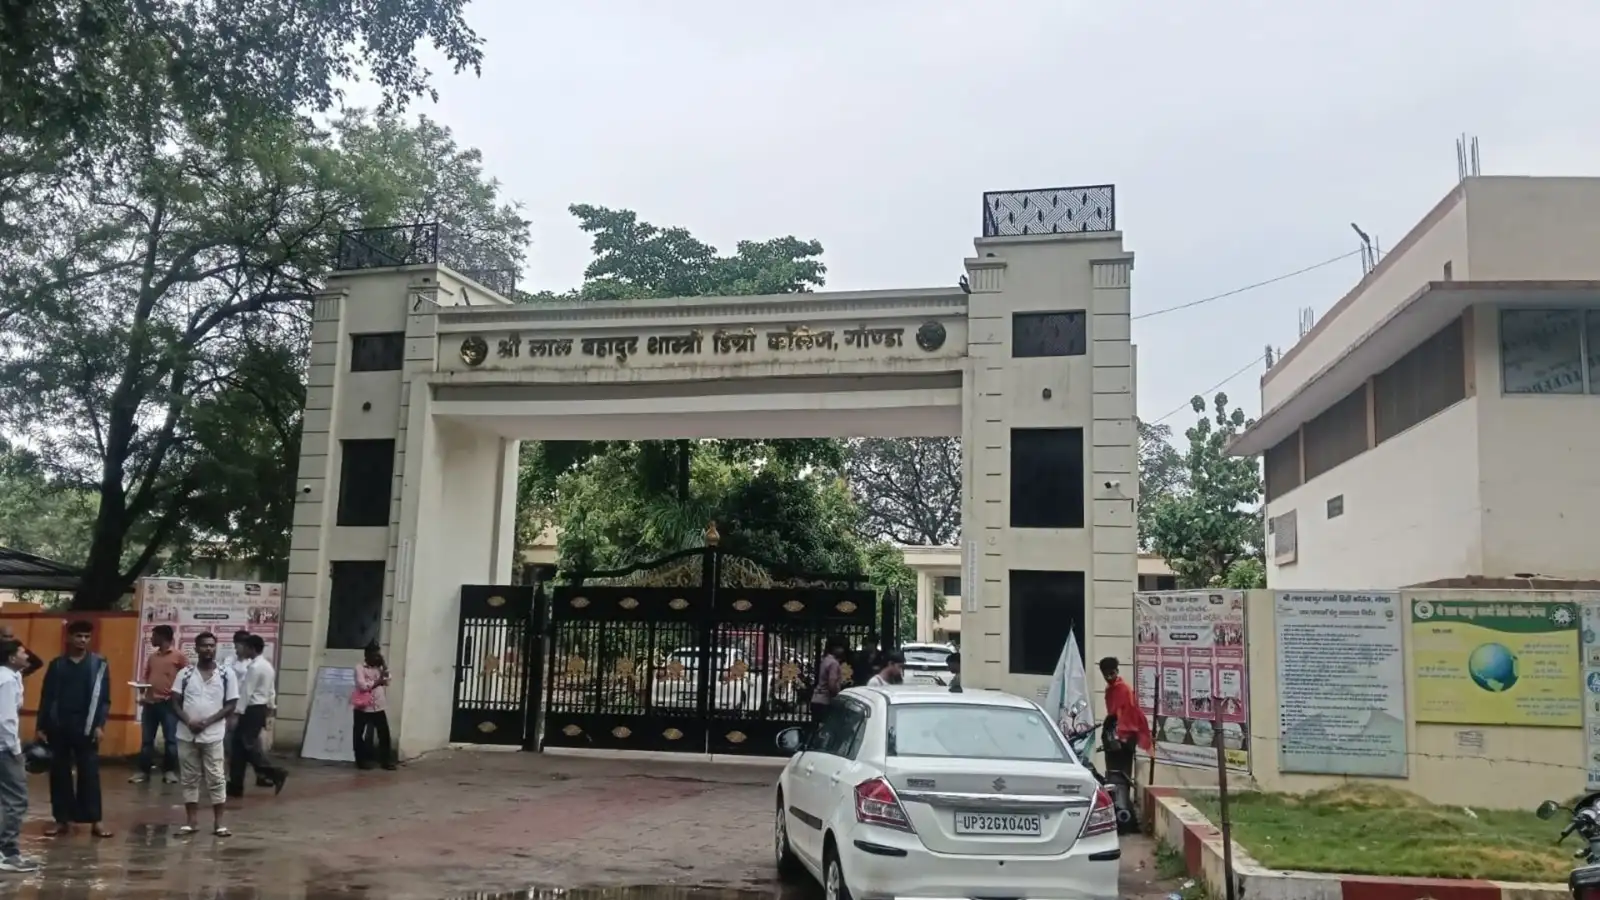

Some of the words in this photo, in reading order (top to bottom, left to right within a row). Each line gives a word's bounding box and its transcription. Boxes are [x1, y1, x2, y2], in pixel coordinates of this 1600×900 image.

[498, 331, 521, 359] श्री
[528, 338, 573, 358] लाल
[581, 335, 639, 363] बहादुर
[647, 328, 704, 355] शास्त्री
[963, 815, 1039, 831] UP32GX0405
